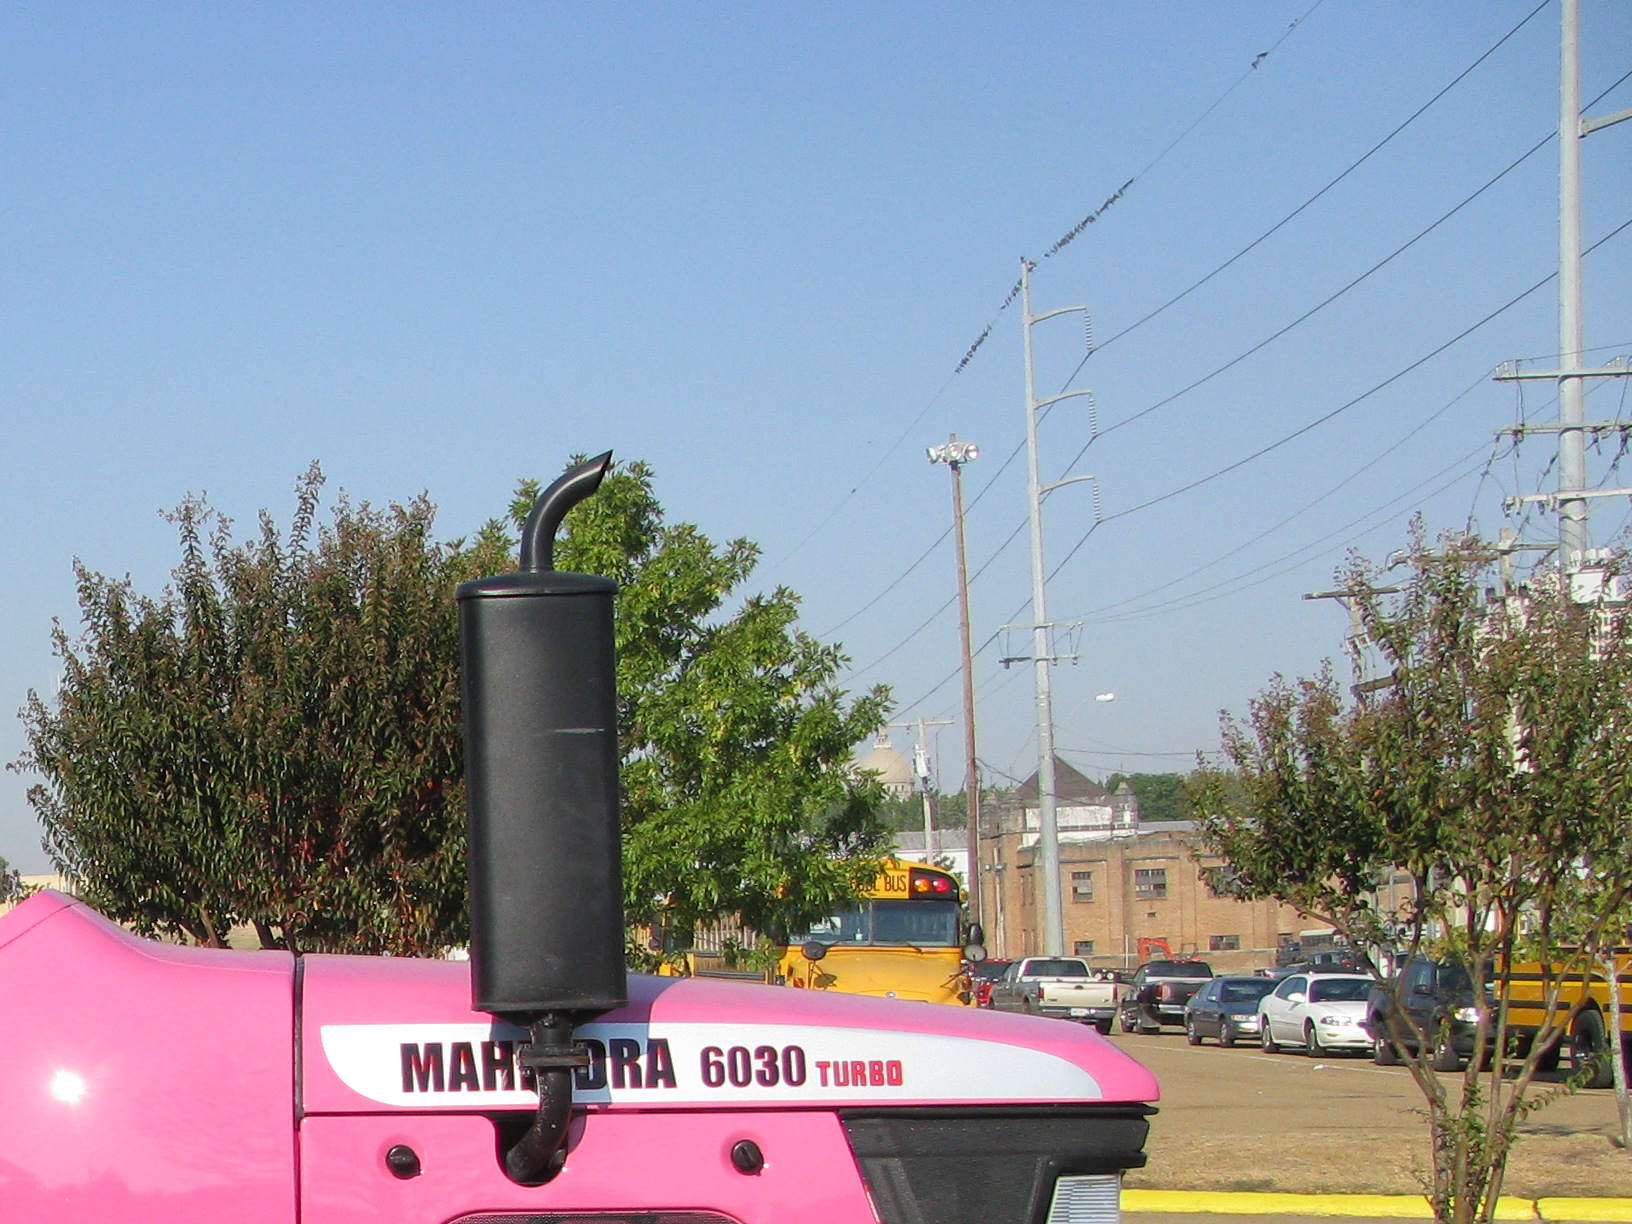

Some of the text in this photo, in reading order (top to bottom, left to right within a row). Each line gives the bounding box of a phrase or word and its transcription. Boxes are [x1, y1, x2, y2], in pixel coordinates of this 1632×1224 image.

[883, 874, 907, 893] BUS
[400, 1038, 904, 1093] MAHDRA 6030 TURBO
